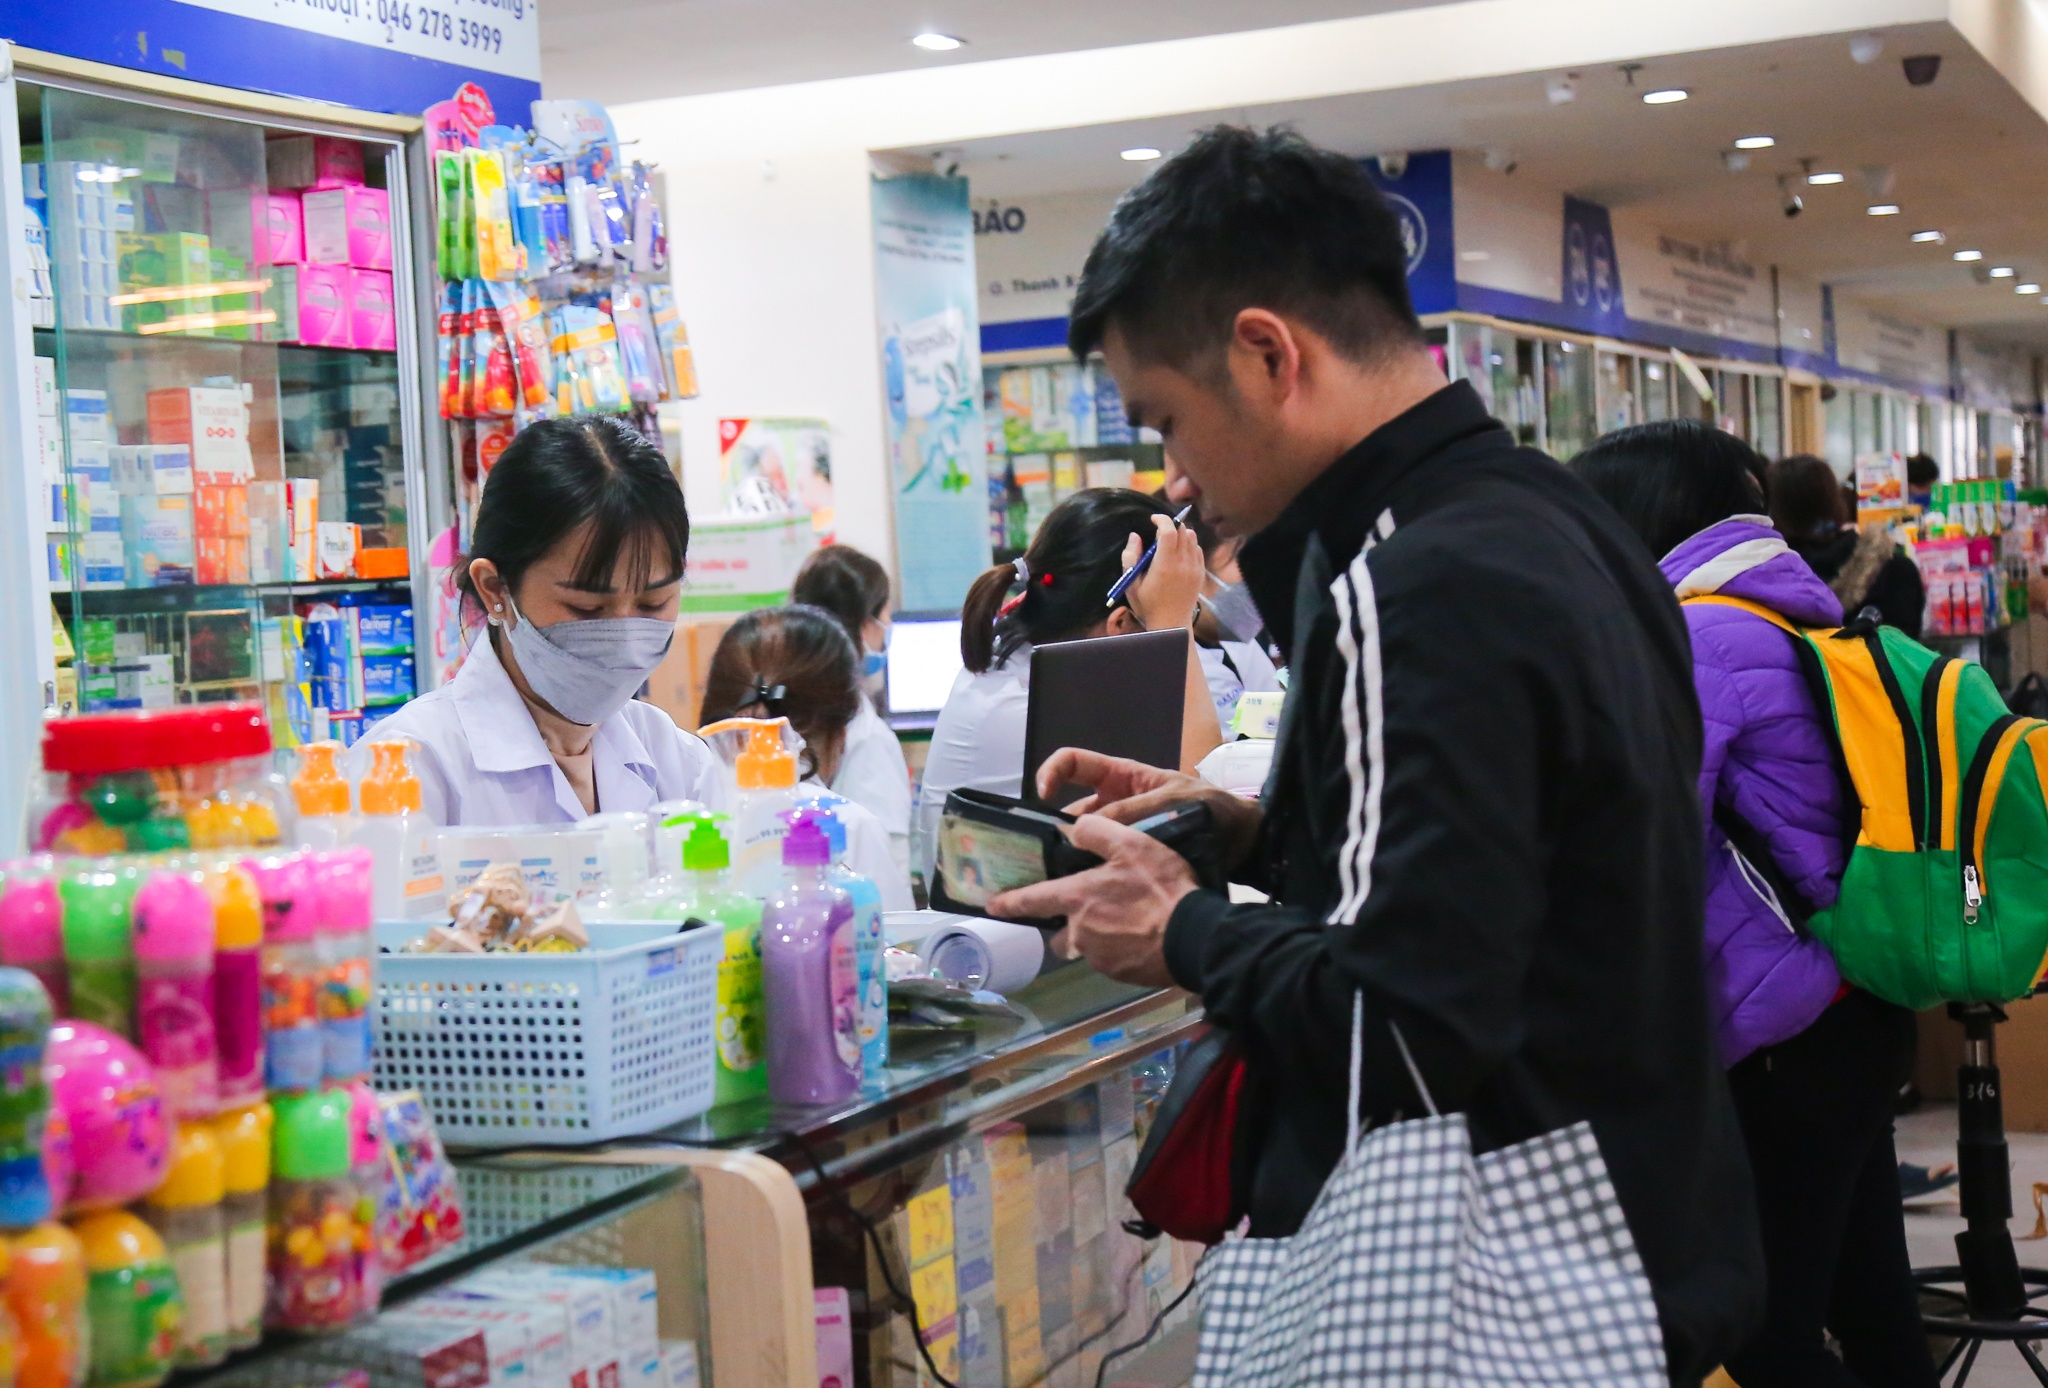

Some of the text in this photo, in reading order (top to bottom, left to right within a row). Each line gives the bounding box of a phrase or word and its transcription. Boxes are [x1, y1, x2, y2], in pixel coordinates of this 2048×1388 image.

[304, 0, 359, 23] oại
[377, 0, 412, 30] 046
[418, 7, 452, 41] 278
[459, 17, 502, 54] 3999
